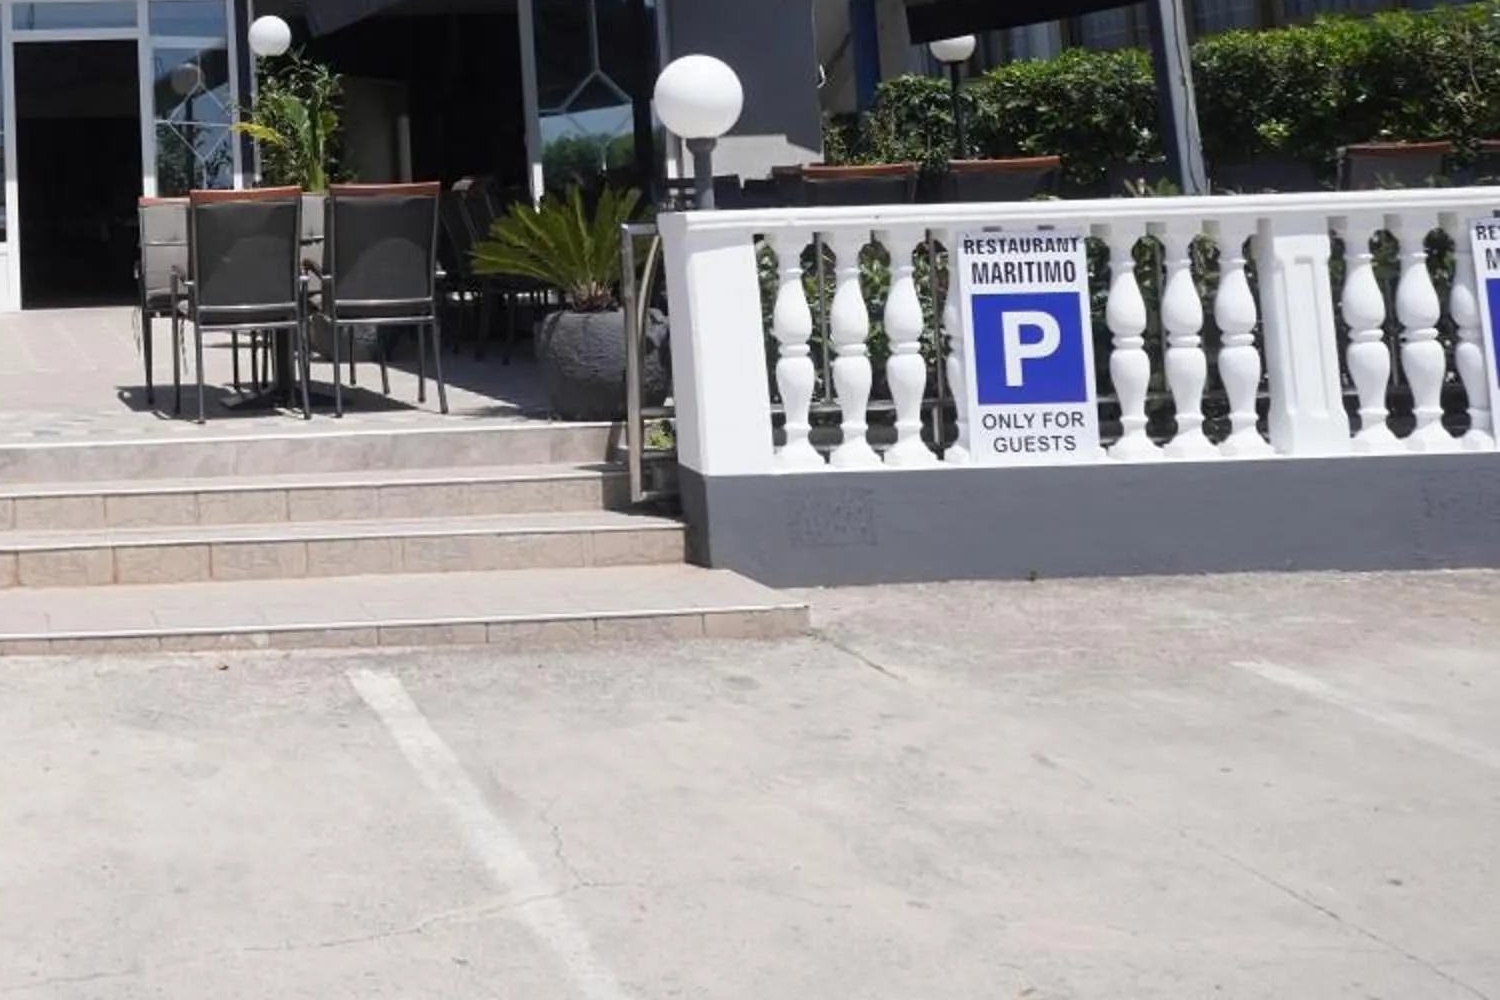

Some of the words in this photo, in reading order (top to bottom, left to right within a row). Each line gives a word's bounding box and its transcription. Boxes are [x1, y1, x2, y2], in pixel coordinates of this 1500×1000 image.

[963, 236, 1081, 255] RESTAURANT
[971, 260, 1077, 285] MARITIMO
[1001, 310, 1061, 387] P
[982, 413, 1035, 430] ONLY
[1043, 411, 1085, 428] FOR
[993, 435, 1077, 453] GUESTS
